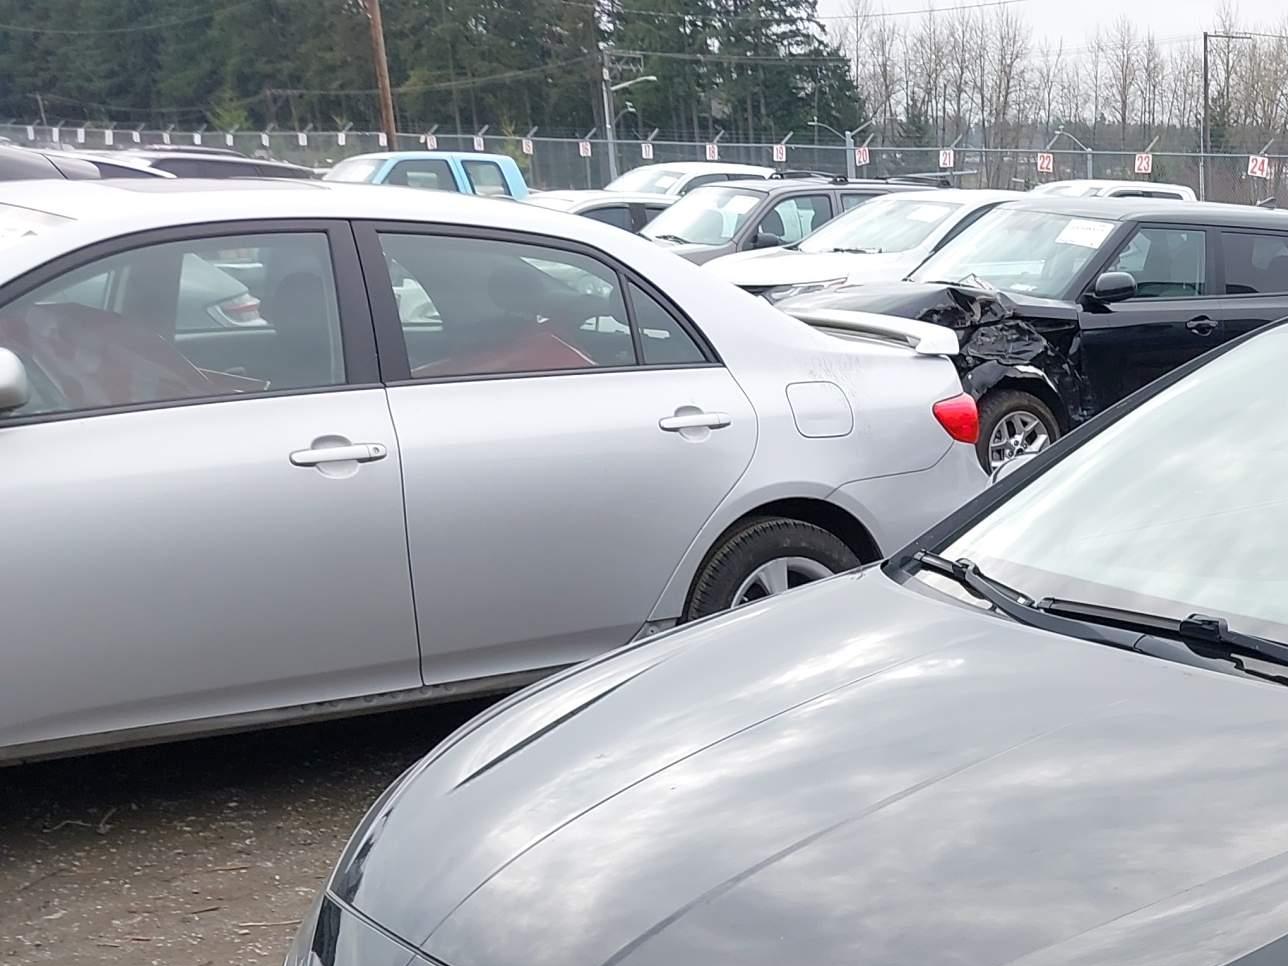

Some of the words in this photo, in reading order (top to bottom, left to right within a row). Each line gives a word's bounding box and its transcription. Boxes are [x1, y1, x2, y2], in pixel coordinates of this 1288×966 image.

[776, 144, 785, 160] 19
[857, 148, 868, 164] 20
[942, 151, 952, 167] 21
[1039, 154, 1052, 171] 22
[1137, 155, 1151, 172] 23
[1250, 157, 1266, 175] 24
